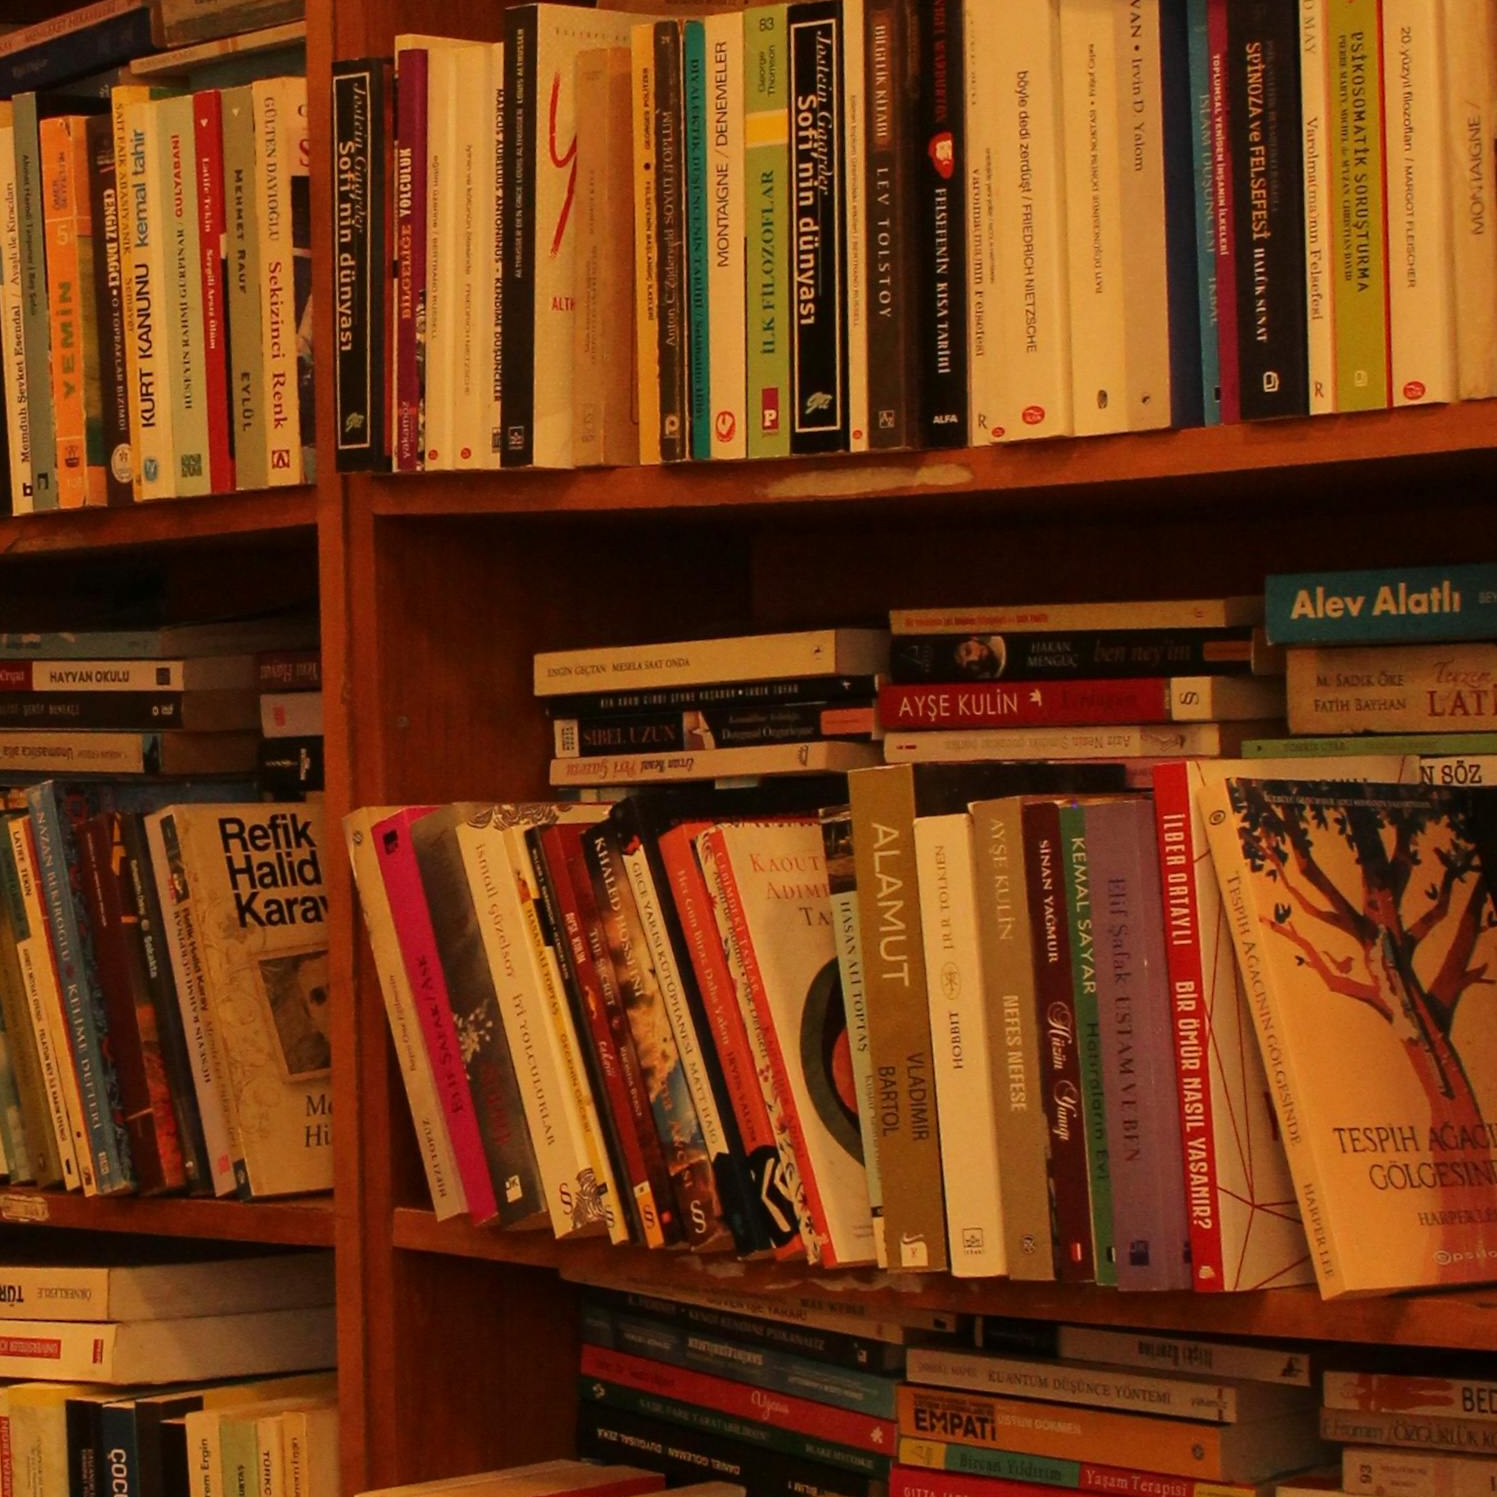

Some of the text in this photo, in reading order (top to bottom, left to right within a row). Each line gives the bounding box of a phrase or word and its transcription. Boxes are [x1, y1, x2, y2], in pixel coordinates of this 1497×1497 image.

[715, 42, 728, 147] DENEMELER
[1014, 71, 1033, 107] böyle
[1246, 42, 1264, 117] SPİNOZA
[815, 31, 833, 196] Jostein Gaarder
[1018, 111, 1034, 139] dedi
[1248, 121, 1262, 141] ve
[1018, 143, 1036, 192] zerdüşt
[1250, 145, 1271, 241] FELSEFESİ
[716, 164, 730, 268] MONTAIGNE
[796, 94, 819, 325] Sofi'nin dünyası
[876, 168, 892, 318] LEV TOLSTOY
[1022, 205, 1035, 275] FRIEDRICH
[132, 128, 156, 427] KURT KANUNU kemal tahir
[337, 141, 357, 351] Sofi'nin dünyası
[935, 188, 954, 374] FELSEFENİN KISA TARİHİ
[1255, 298, 1268, 342] SUNAT
[1291, 581, 1461, 620] Alev Alatlı
[900, 687, 1019, 721] AYŞE KULİN
[218, 813, 317, 854] Refik
[1039, 840, 1055, 890] SİNAN
[1163, 814, 1189, 865] İLBER
[226, 850, 322, 891] Halid
[234, 892, 328, 928] Kara
[872, 823, 909, 987] ALAMUT
[1041, 896, 1060, 963] YAĞMUR
[1072, 837, 1096, 994] KEMAL SAYAR
[1168, 874, 1193, 945] ORTAYLI
[1176, 981, 1200, 1012] BİR
[1179, 1018, 1204, 1069] ÖMÜR
[878, 1066, 898, 1137] BARTOL
[1182, 1077, 1207, 1132] NASIL
[1243, 939, 1275, 1034] AĞACININ
[1267, 1035, 1304, 1145] GÖLGESİNDE
[1303, 1183, 1328, 1247] HARPER
[1319, 1250, 1336, 1281] LEE
[913, 1406, 998, 1443] EMPATİ
